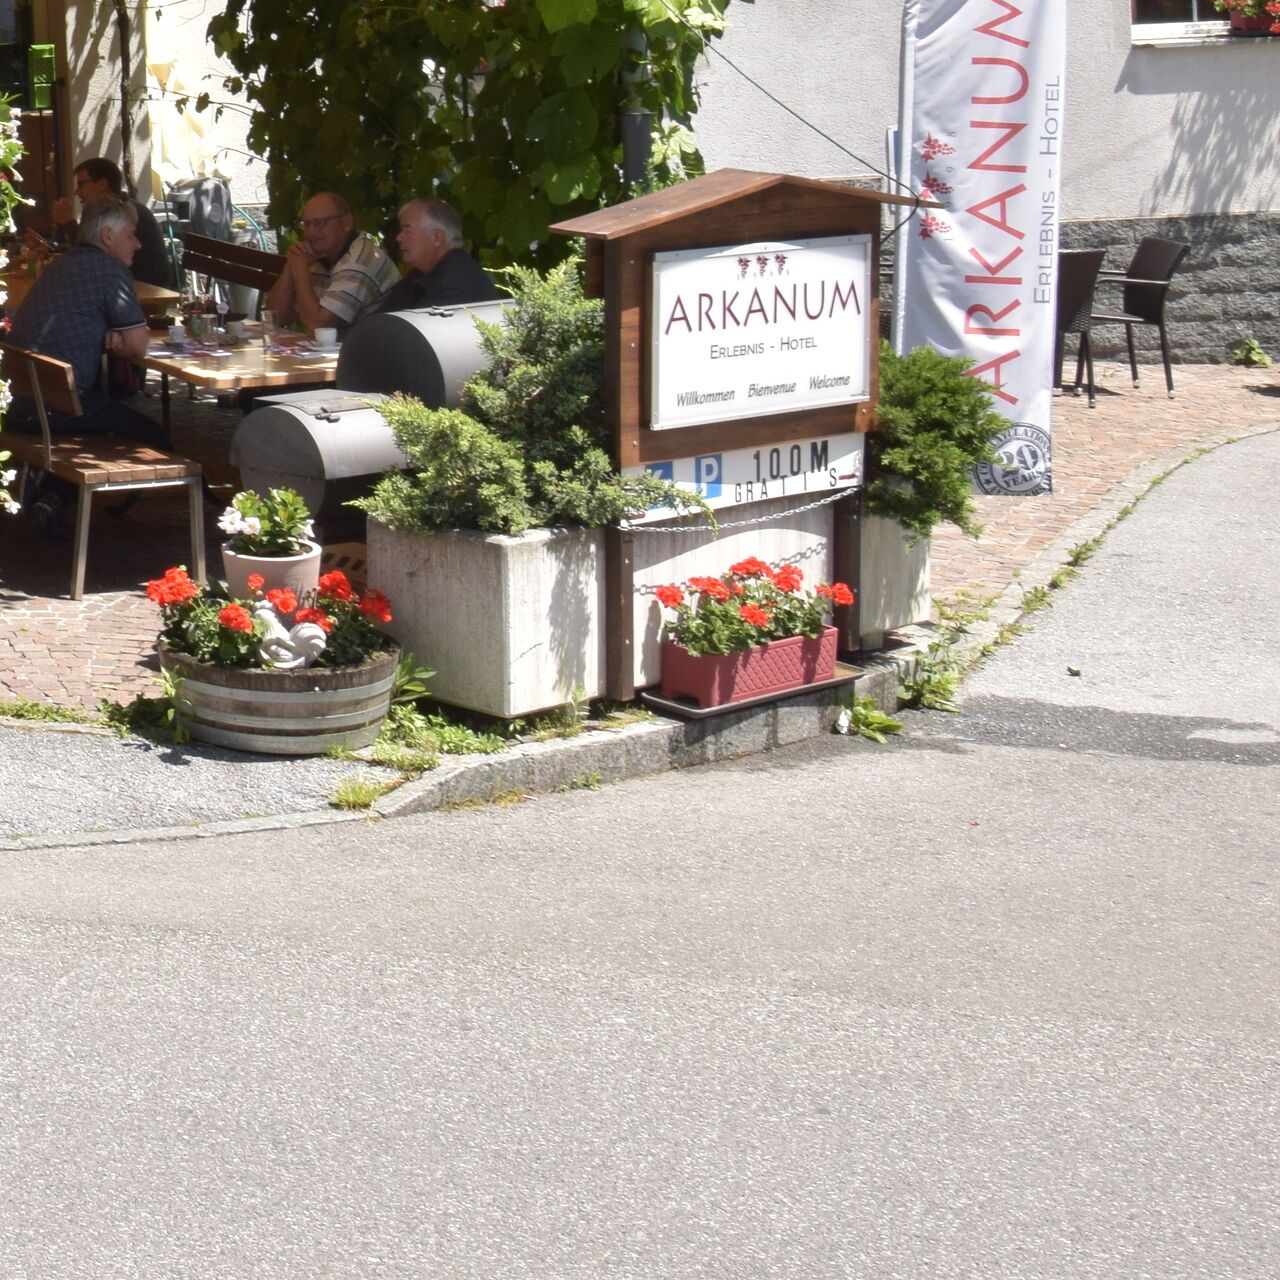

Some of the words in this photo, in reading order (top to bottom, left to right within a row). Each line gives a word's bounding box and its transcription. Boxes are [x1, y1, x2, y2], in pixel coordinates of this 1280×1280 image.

[665, 280, 861, 335] ARKANUM
[676, 389, 735, 407] Willkommen
[748, 381, 797, 398] Bienvenue
[809, 374, 851, 390] Welcome
[735, 468, 837, 503] GRATIS
